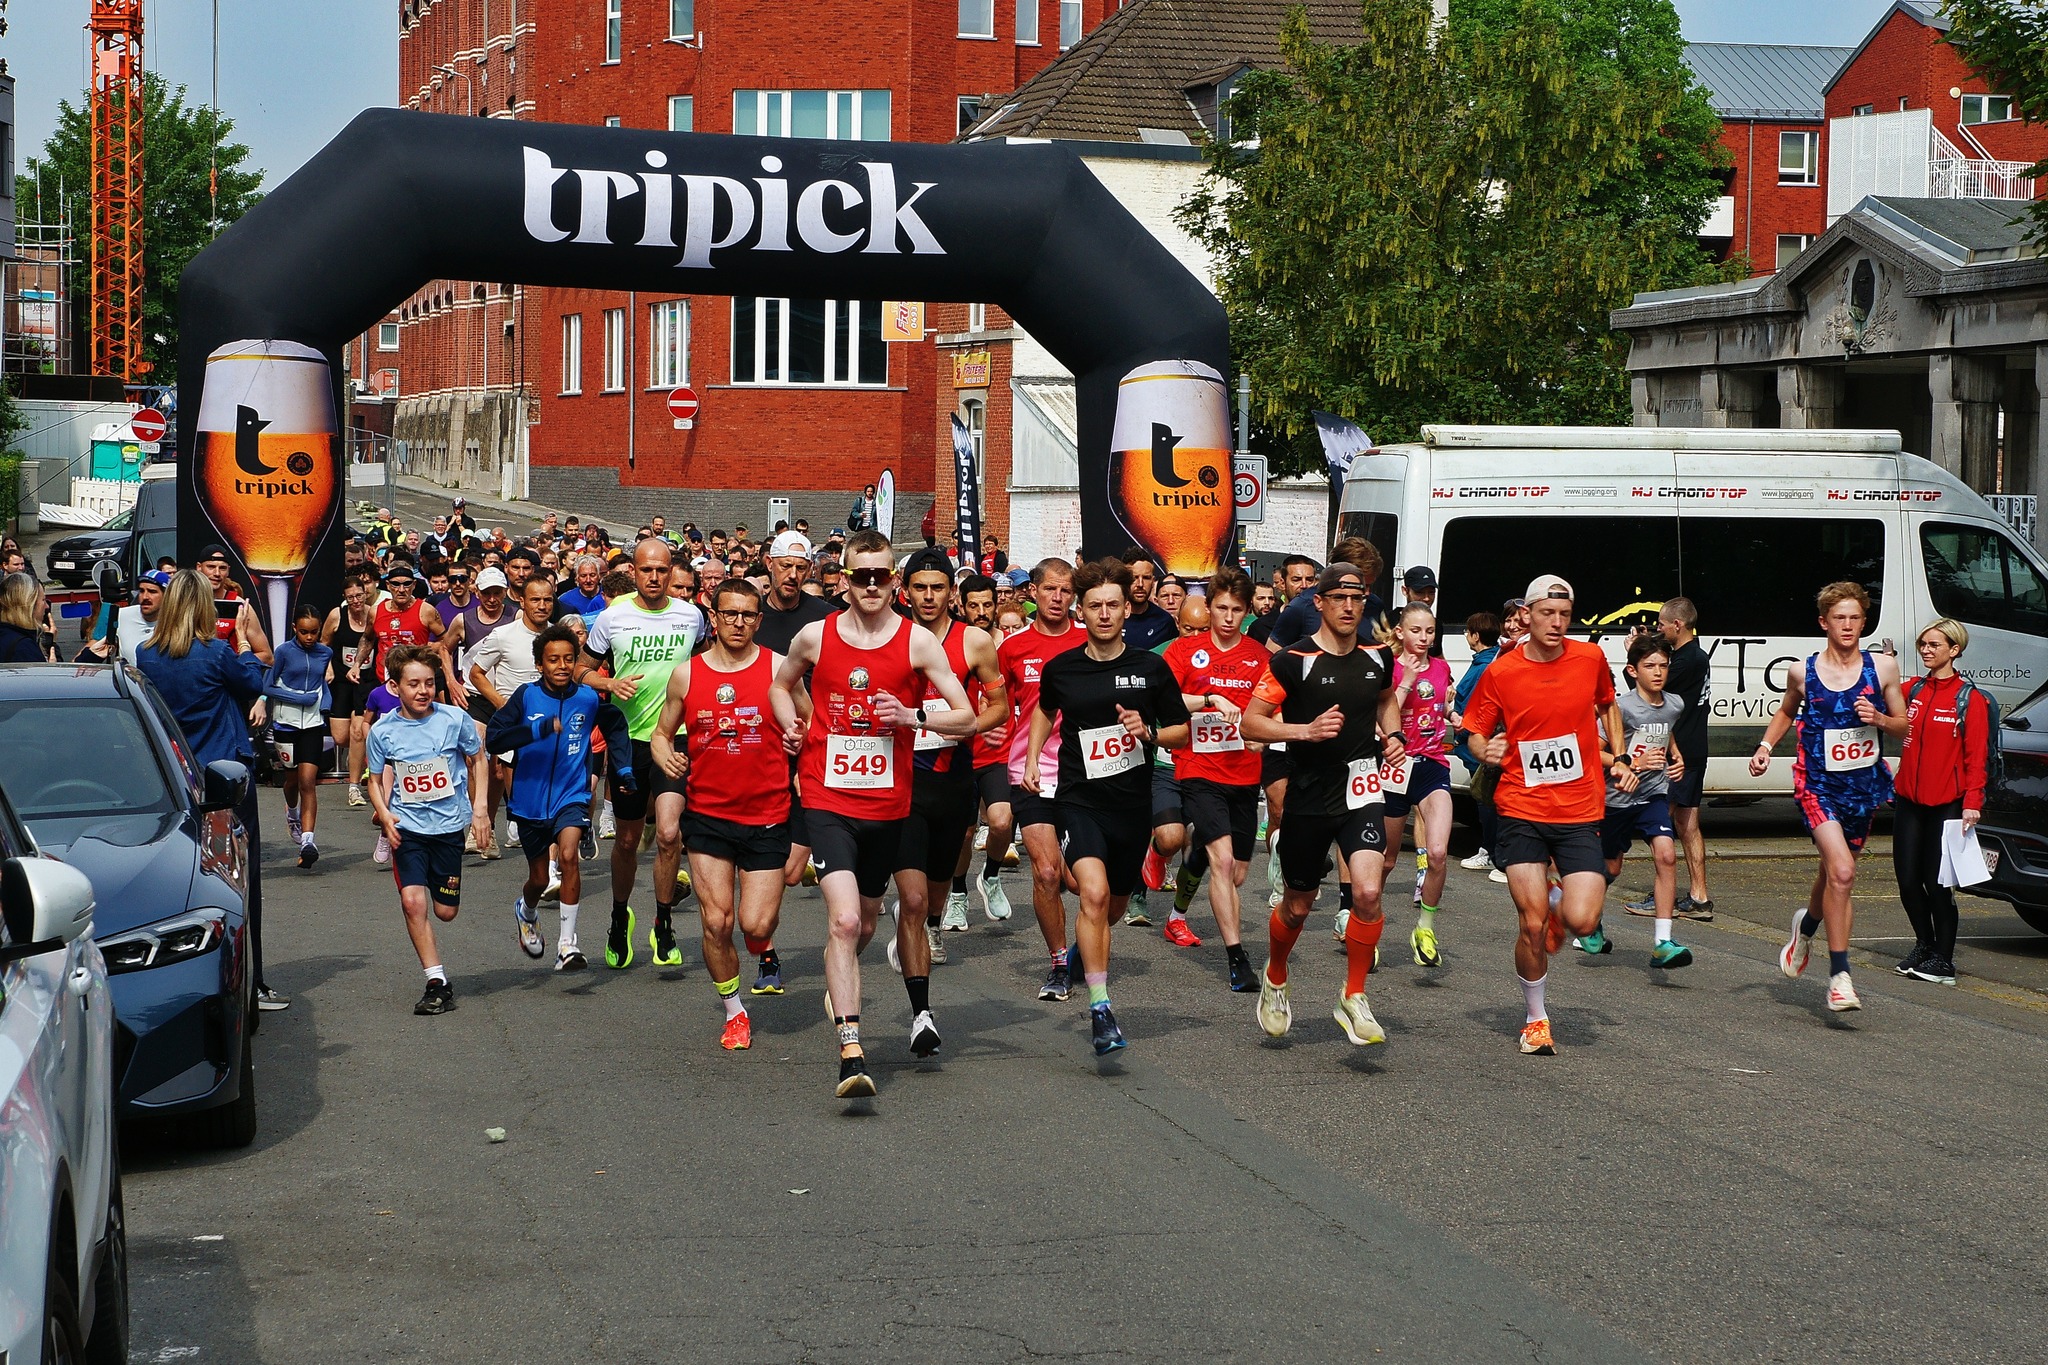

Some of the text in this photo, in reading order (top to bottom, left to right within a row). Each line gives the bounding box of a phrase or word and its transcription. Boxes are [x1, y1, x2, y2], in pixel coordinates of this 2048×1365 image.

[523, 146, 948, 269] tripick
[235, 479, 315, 498] tripick
[1235, 484, 1253, 496] 30
[1432, 488, 1454, 498] MJ
[1563, 488, 1618, 497] www.jogging.org
[1631, 487, 1653, 497] MJ
[1761, 489, 1814, 499] www.jogging.org
[1827, 490, 1849, 500] MJ
[1153, 491, 1221, 509] tripick
[632, 634, 685, 648] RUN IN
[630, 648, 675, 662] LIEGE
[1213, 664, 1238, 674] SER
[1131, 674, 1146, 686] Gym
[1933, 715, 1956, 723] LAURA
[1197, 724, 1239, 743] 552
[1831, 740, 1875, 762] 662
[833, 754, 887, 776] 549
[1529, 748, 1575, 774] 440
[403, 771, 448, 794] 656
